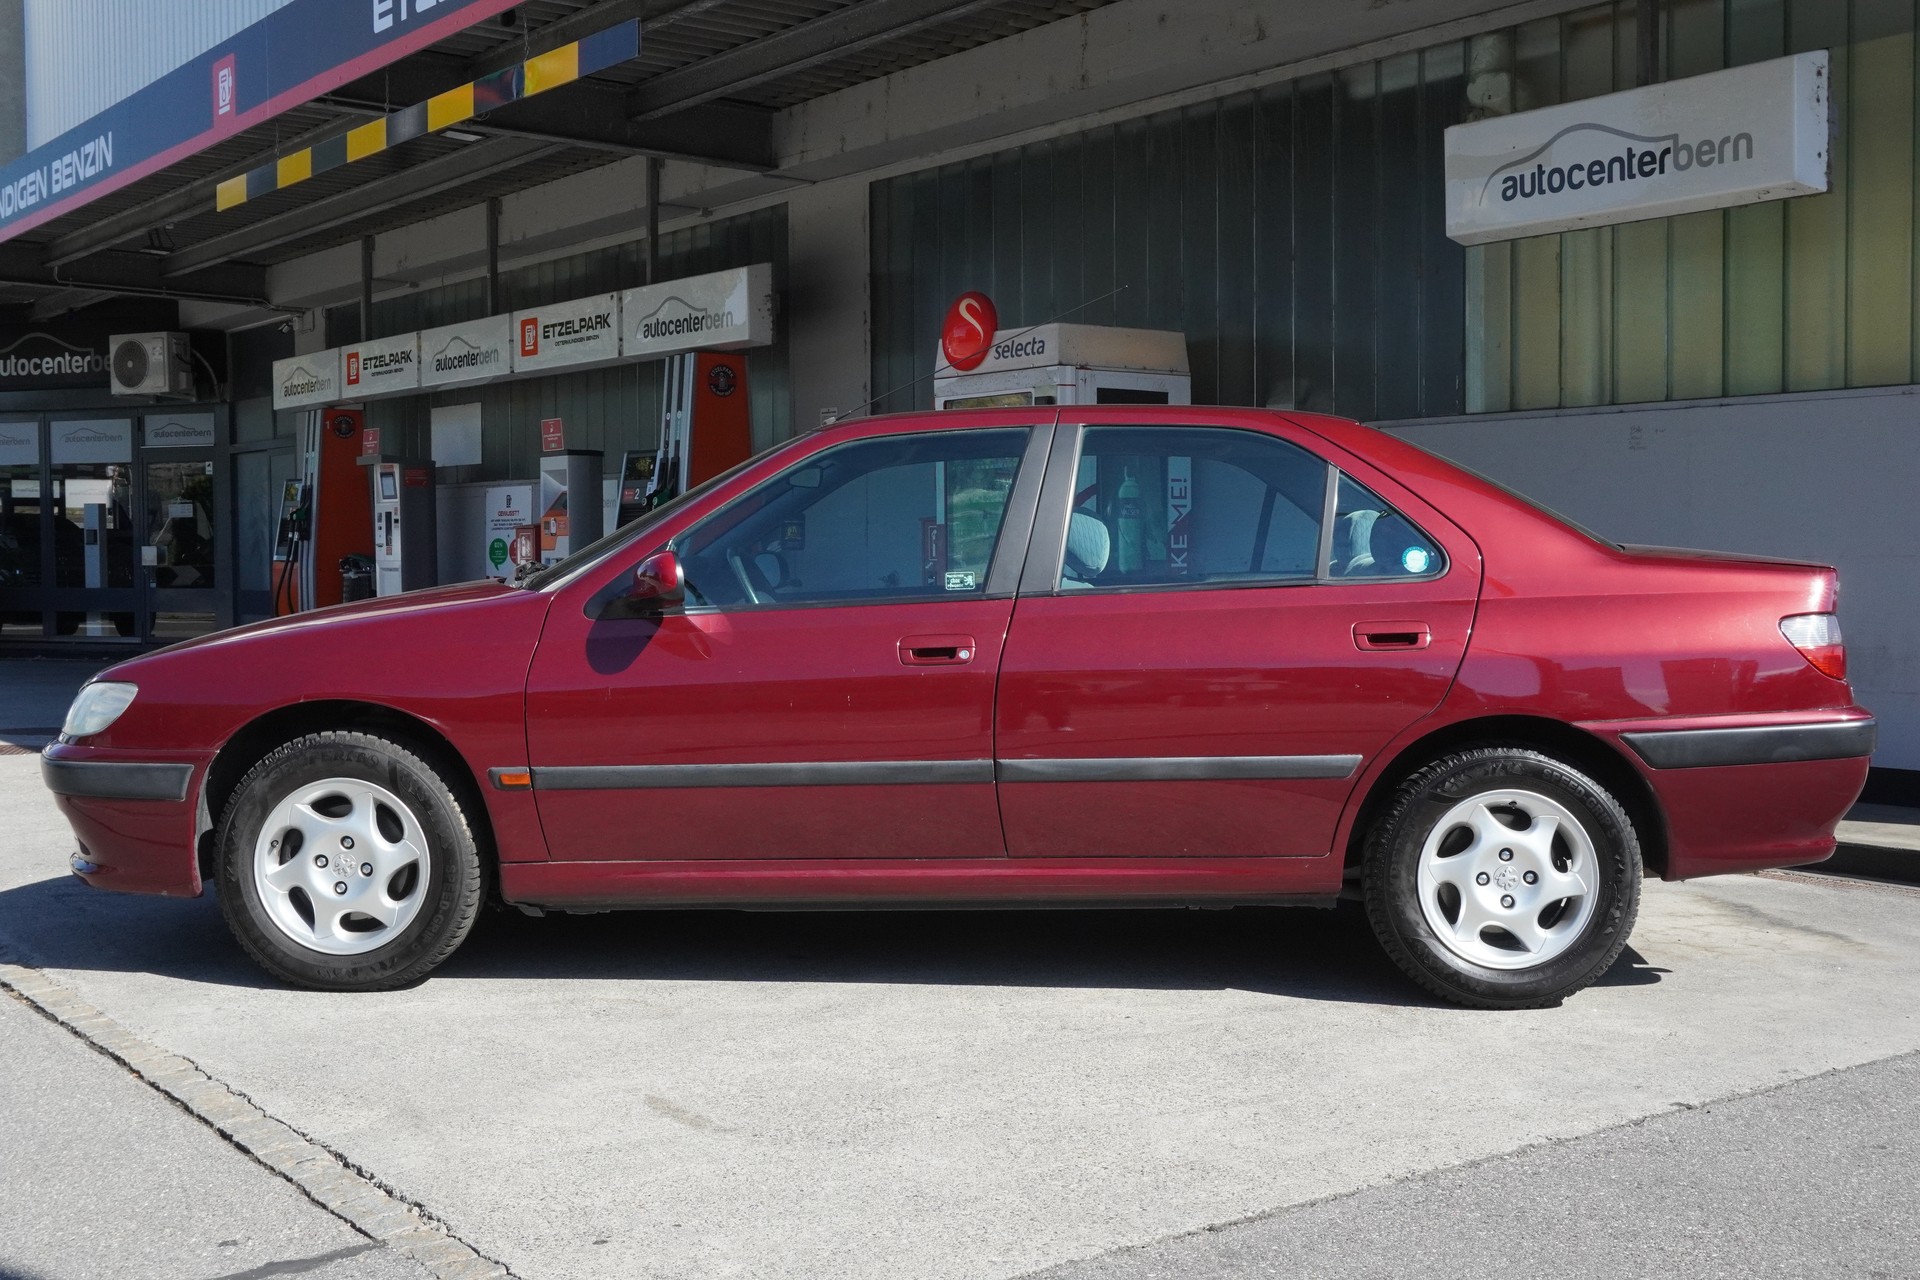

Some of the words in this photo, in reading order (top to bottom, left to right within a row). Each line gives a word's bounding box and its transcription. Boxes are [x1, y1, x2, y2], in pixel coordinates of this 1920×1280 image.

[52, 131, 113, 194] BENZIN
[1501, 132, 1753, 202] autocenterbern
[542, 313, 611, 340] ETZELPARK
[643, 308, 734, 339] autocenterbern
[362, 350, 413, 371] ETZELPARK
[436, 347, 499, 372] autocenterbern
[994, 337, 1046, 360] selecta
[283, 377, 332, 398] autocenterbern
[153, 428, 212, 438] autocenterbern
[634, 488, 640, 500] 2
[1542, 768, 1612, 827] SPEED-GRIP
